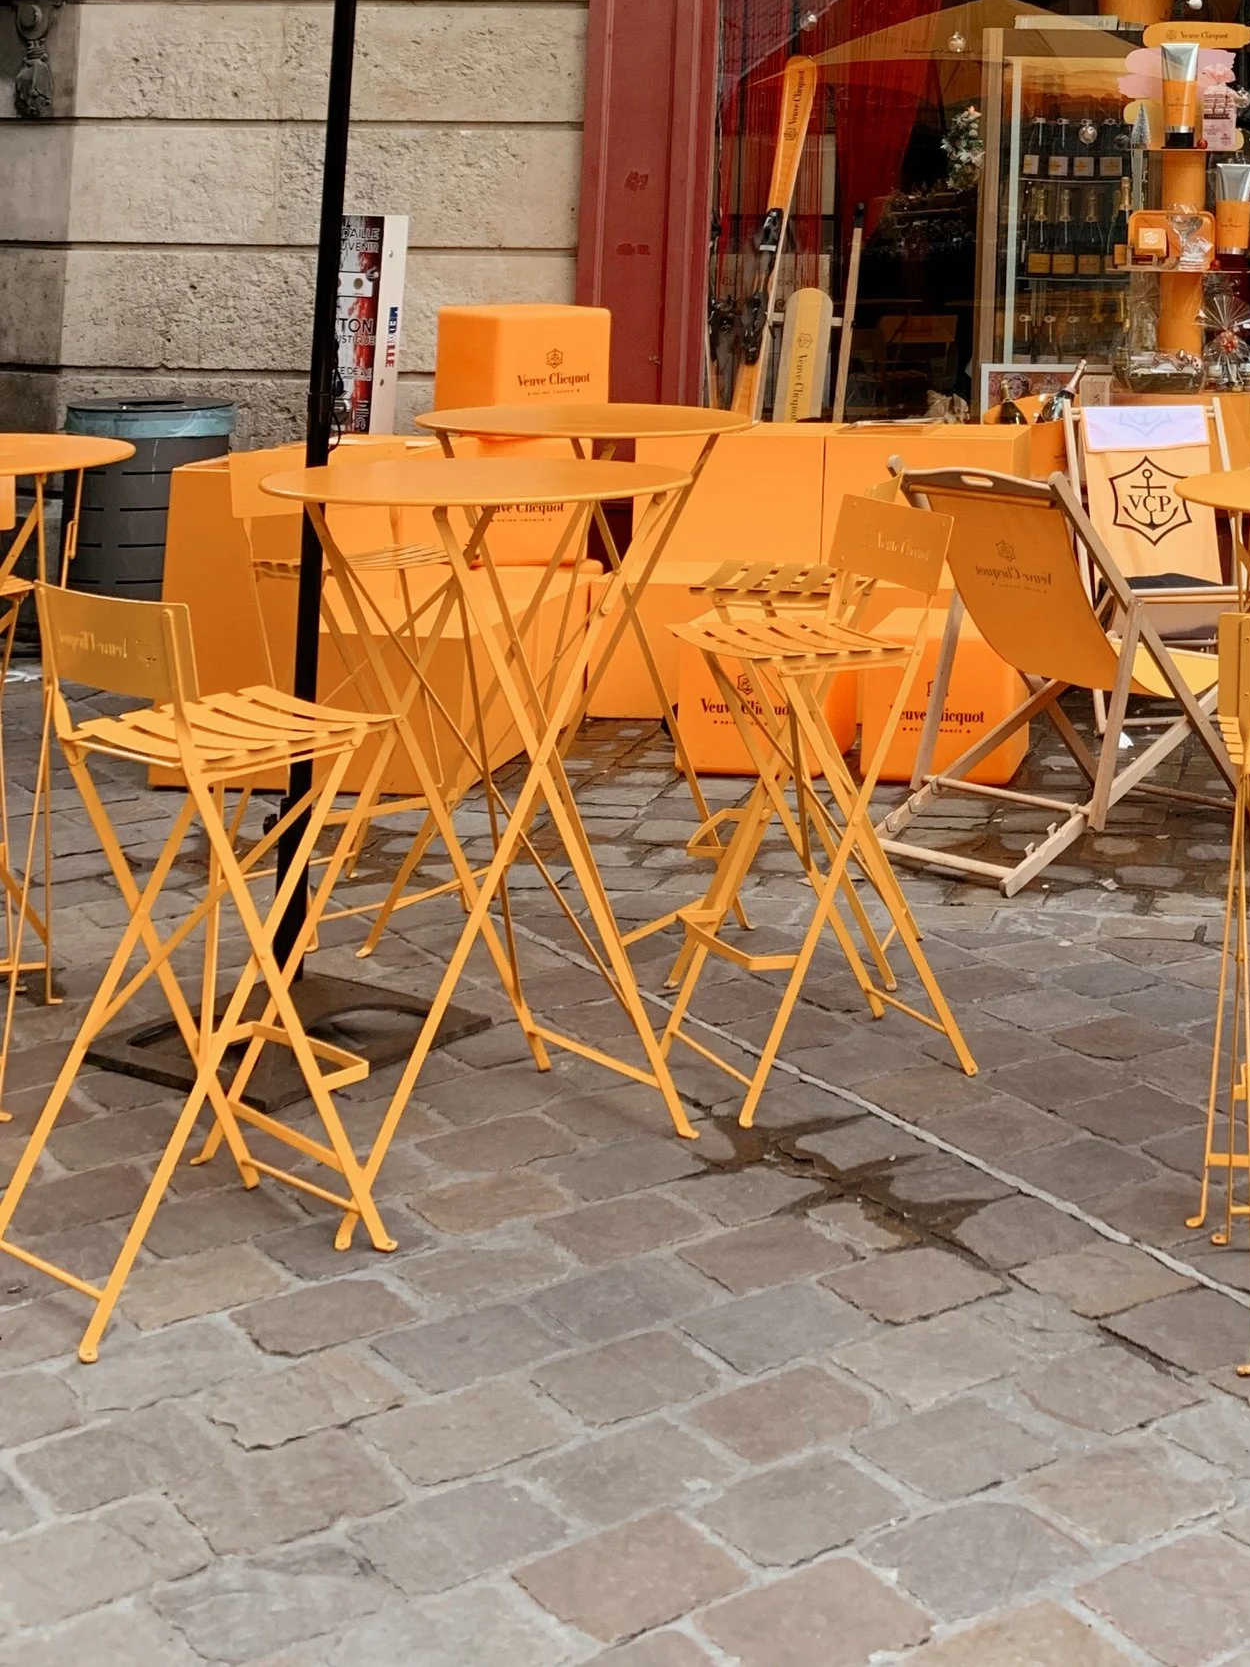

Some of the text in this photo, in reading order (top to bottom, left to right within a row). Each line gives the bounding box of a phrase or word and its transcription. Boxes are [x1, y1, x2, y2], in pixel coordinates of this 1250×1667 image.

[517, 372, 590, 386] Veuve Clicquot
[1127, 494, 1172, 513] VCP
[701, 697, 729, 713] Veuv
